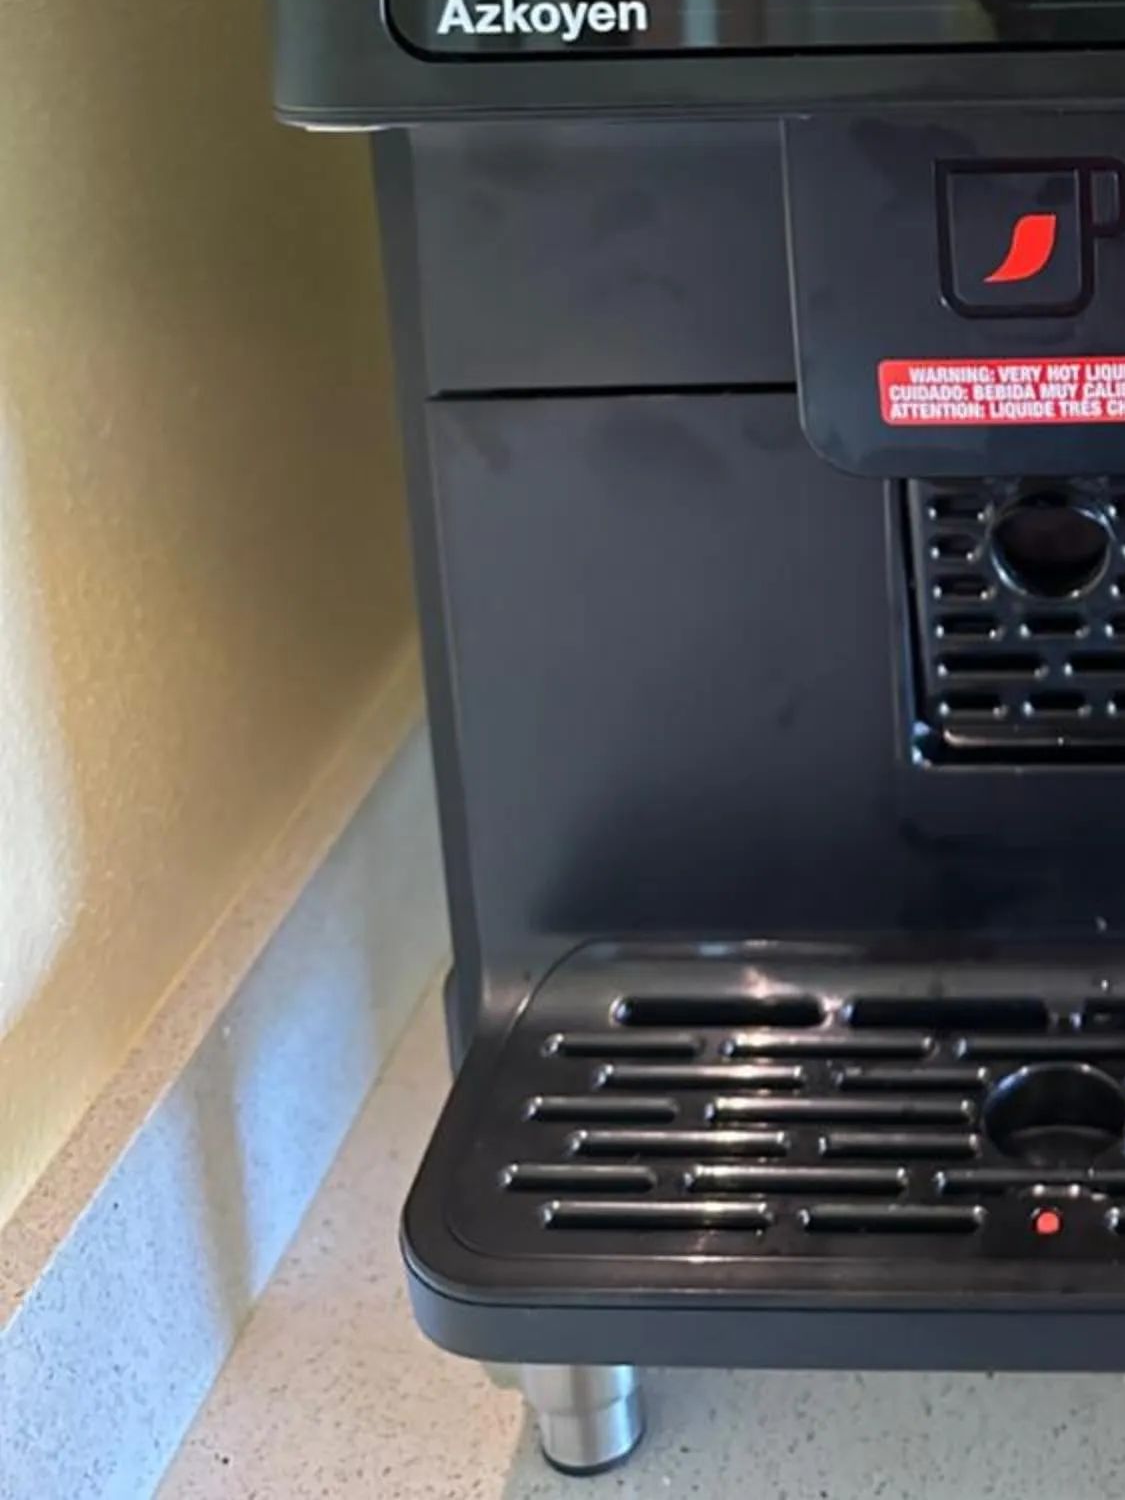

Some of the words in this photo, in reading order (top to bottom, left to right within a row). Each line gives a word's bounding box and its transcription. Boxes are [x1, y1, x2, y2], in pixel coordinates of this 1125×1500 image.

[908, 365, 995, 384] WARNING:
[996, 364, 1042, 382] VERY
[1047, 363, 1080, 381] HOT
[889, 383, 969, 402] CUIDADO:
[973, 383, 1036, 401] BEBIDA
[1040, 382, 1079, 400] MUY
[890, 401, 985, 420] ATTENTION:
[989, 400, 1055, 419] LIQUIDE
